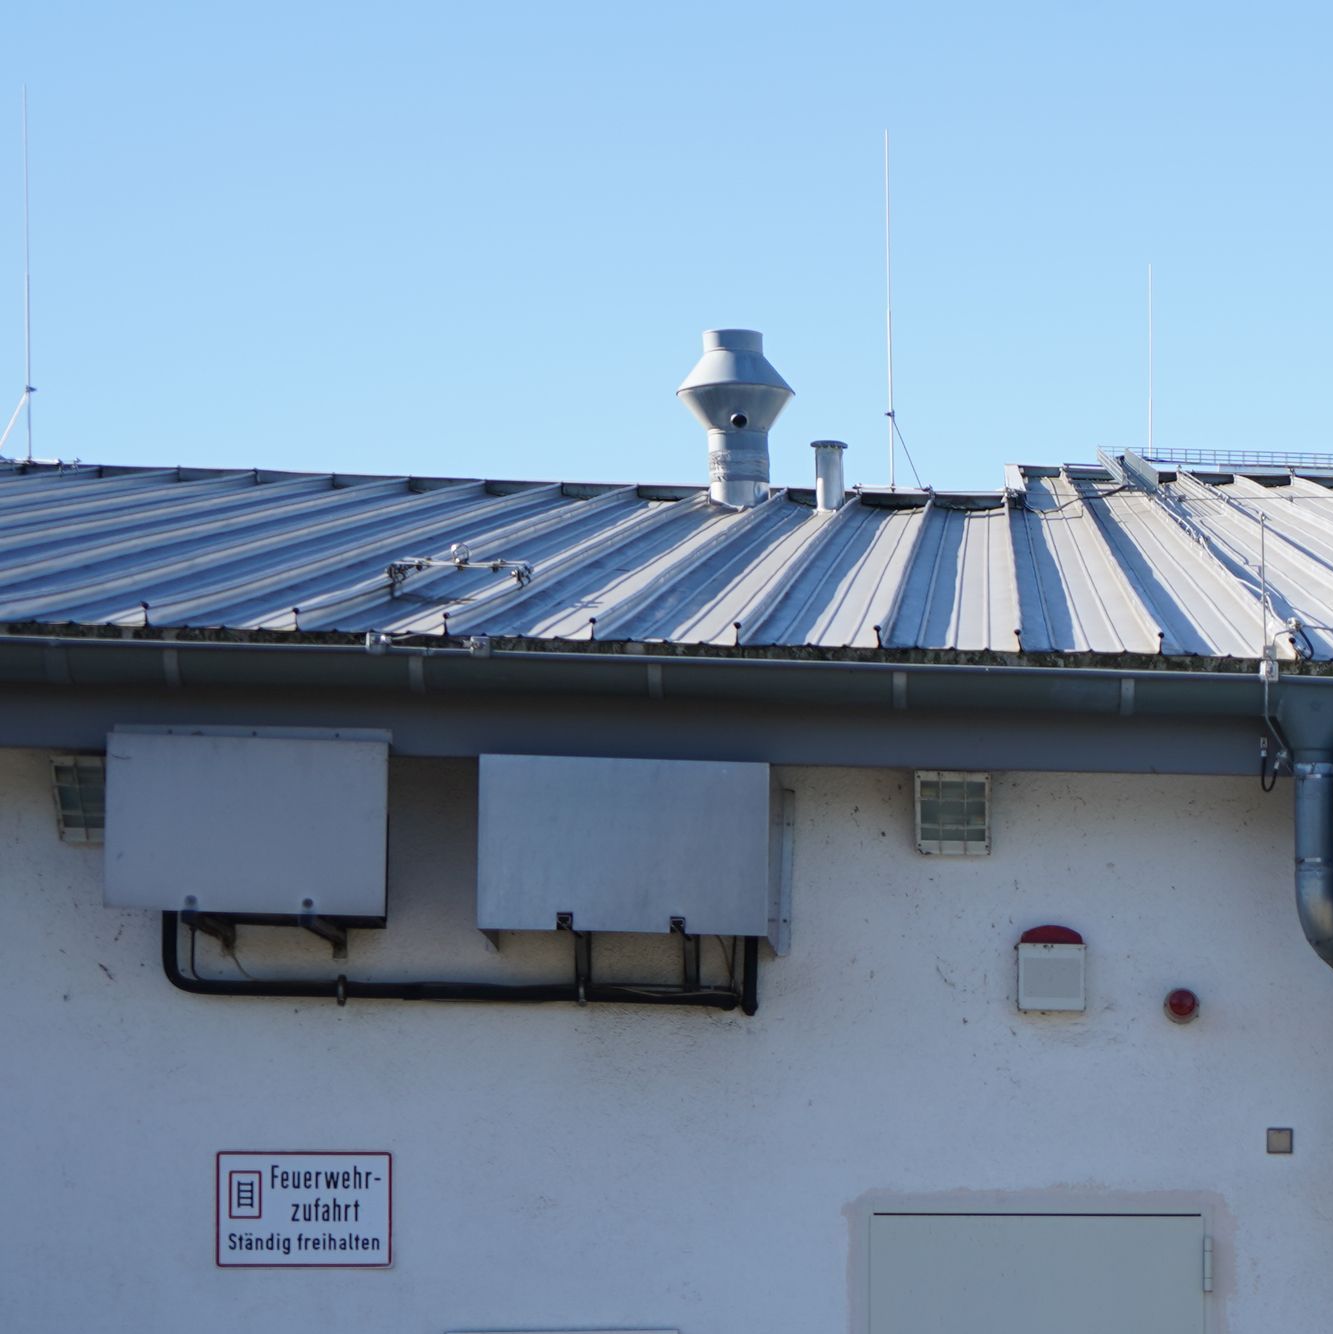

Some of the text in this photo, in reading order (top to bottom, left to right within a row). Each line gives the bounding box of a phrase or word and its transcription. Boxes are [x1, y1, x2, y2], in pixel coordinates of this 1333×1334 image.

[270, 1164, 382, 1190] Feuerwehr-
[290, 1198, 361, 1223] zufahrt
[228, 1232, 381, 1255] Ständig freihalten
